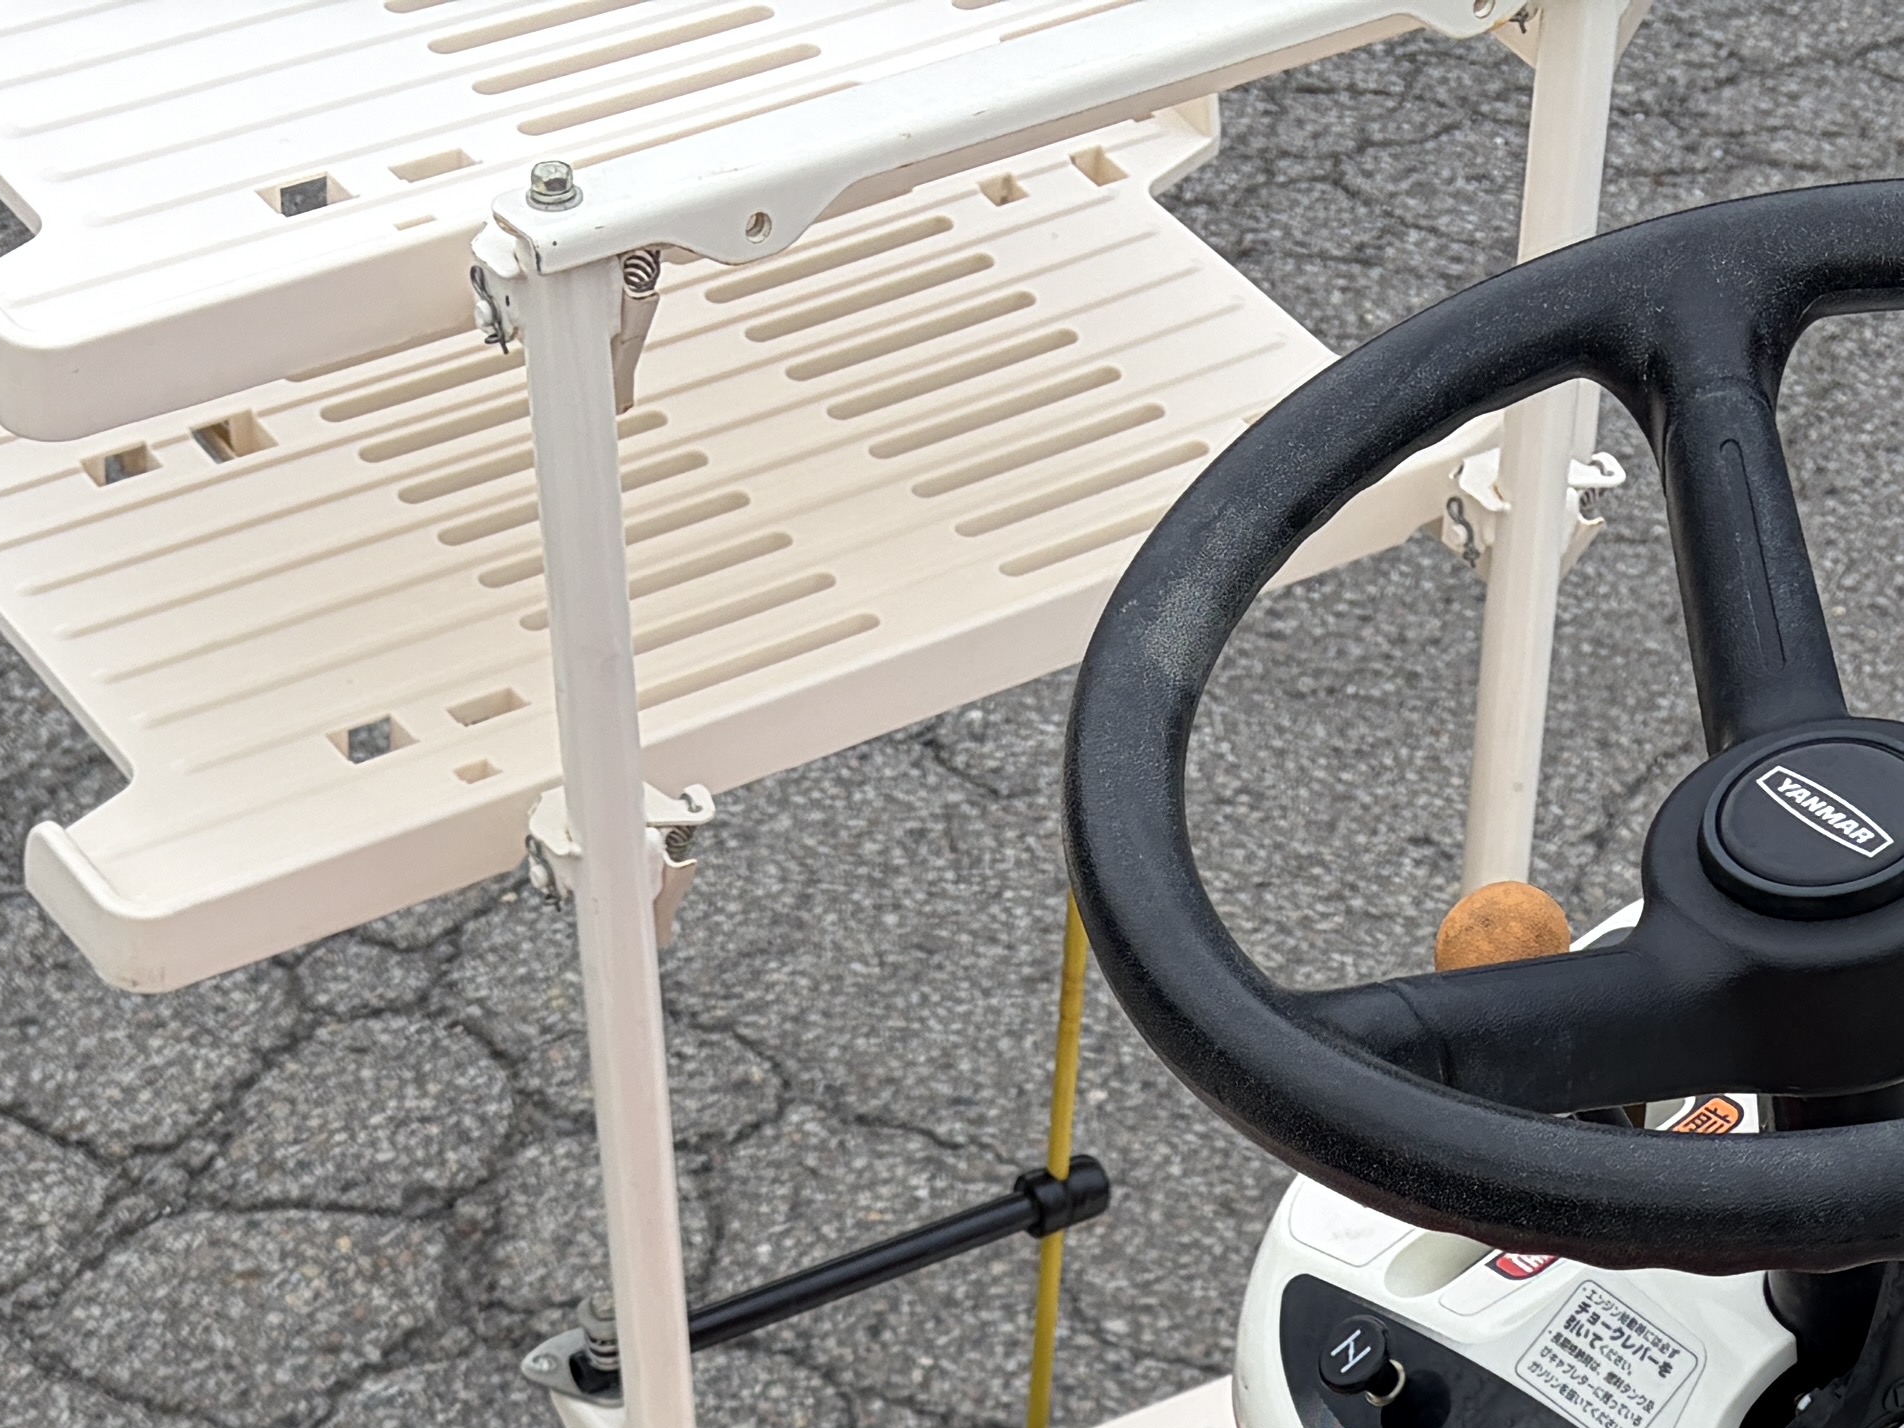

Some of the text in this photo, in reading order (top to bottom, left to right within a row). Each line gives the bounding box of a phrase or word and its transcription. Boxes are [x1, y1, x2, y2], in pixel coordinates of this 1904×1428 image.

[1776, 776, 1876, 846] YANMAR
[1575, 1301, 1673, 1378] チョークレバーを
